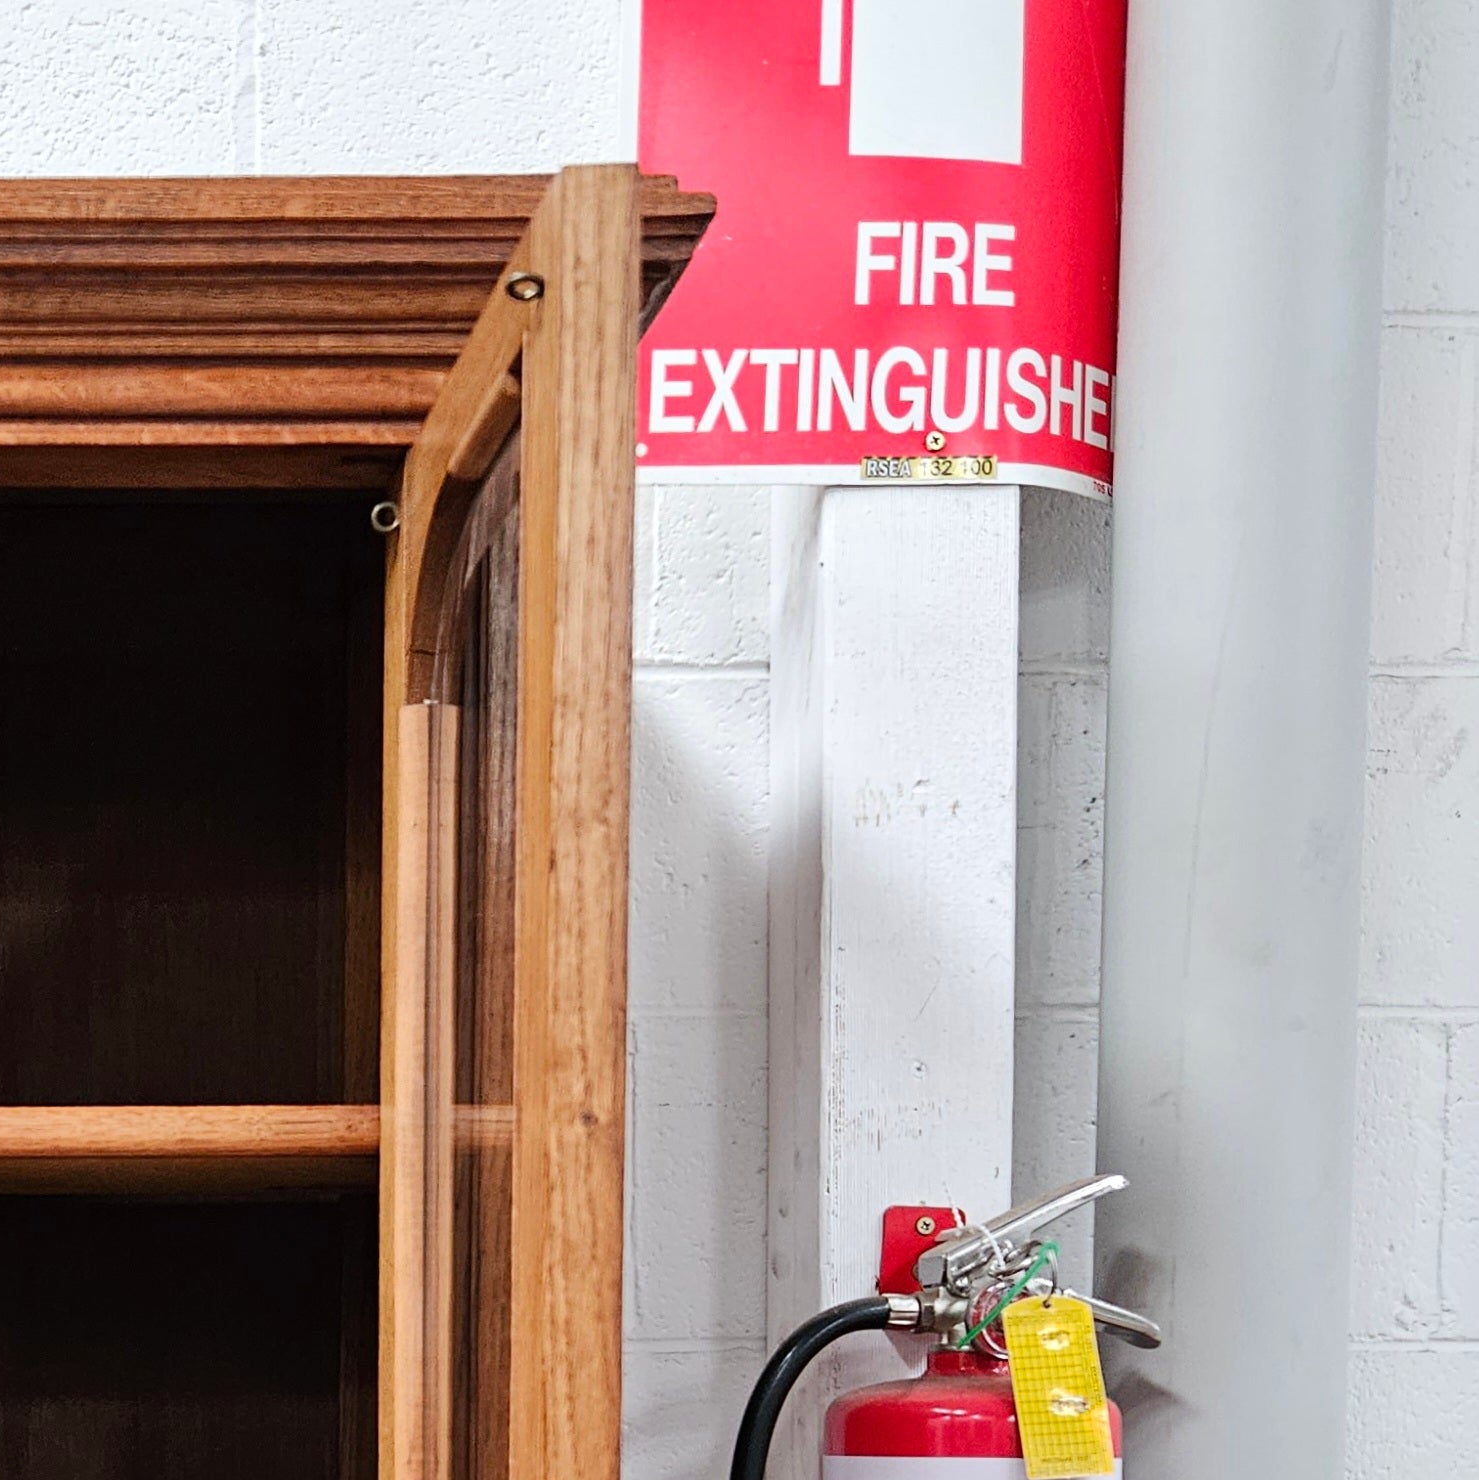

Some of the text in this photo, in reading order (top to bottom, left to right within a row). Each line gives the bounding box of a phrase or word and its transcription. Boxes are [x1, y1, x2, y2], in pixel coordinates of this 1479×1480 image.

[855, 221, 1015, 306] FIRE
[648, 345, 1116, 452] EXTINGUISHE
[866, 458, 912, 478] RSEA
